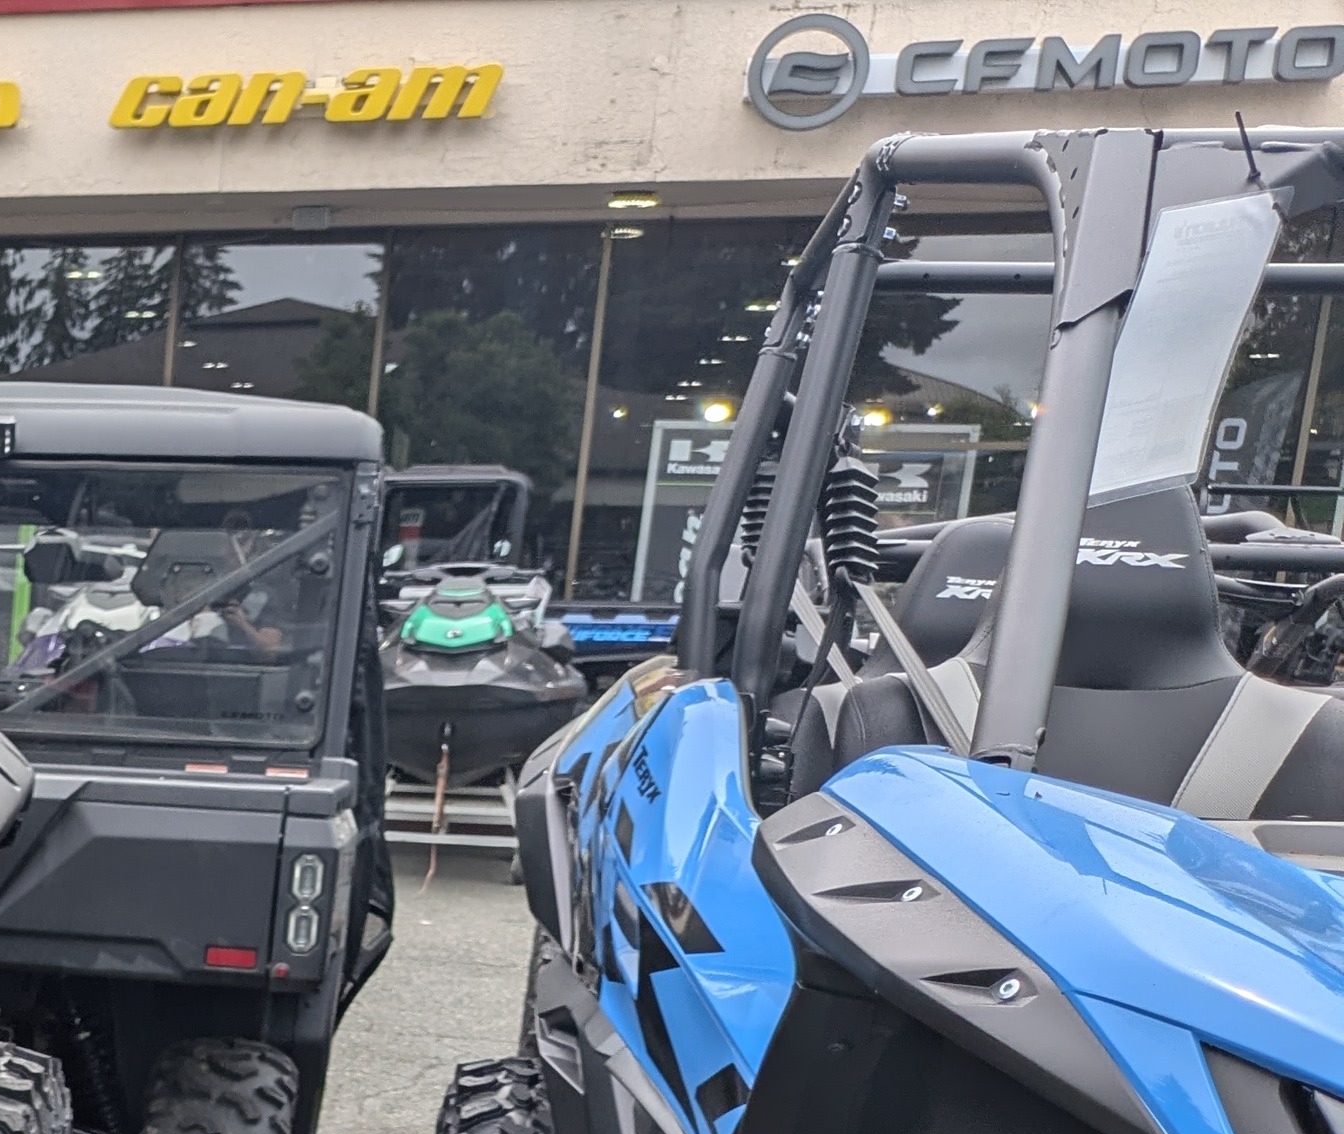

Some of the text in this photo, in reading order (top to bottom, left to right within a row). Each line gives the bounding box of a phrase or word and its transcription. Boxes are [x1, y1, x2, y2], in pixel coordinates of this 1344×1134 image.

[895, 24, 1344, 97] CFMOTO
[108, 62, 505, 129] can-am
[666, 463, 721, 475] Kawasa
[1076, 549, 1189, 569] KRX
[935, 585, 993, 600] KR
